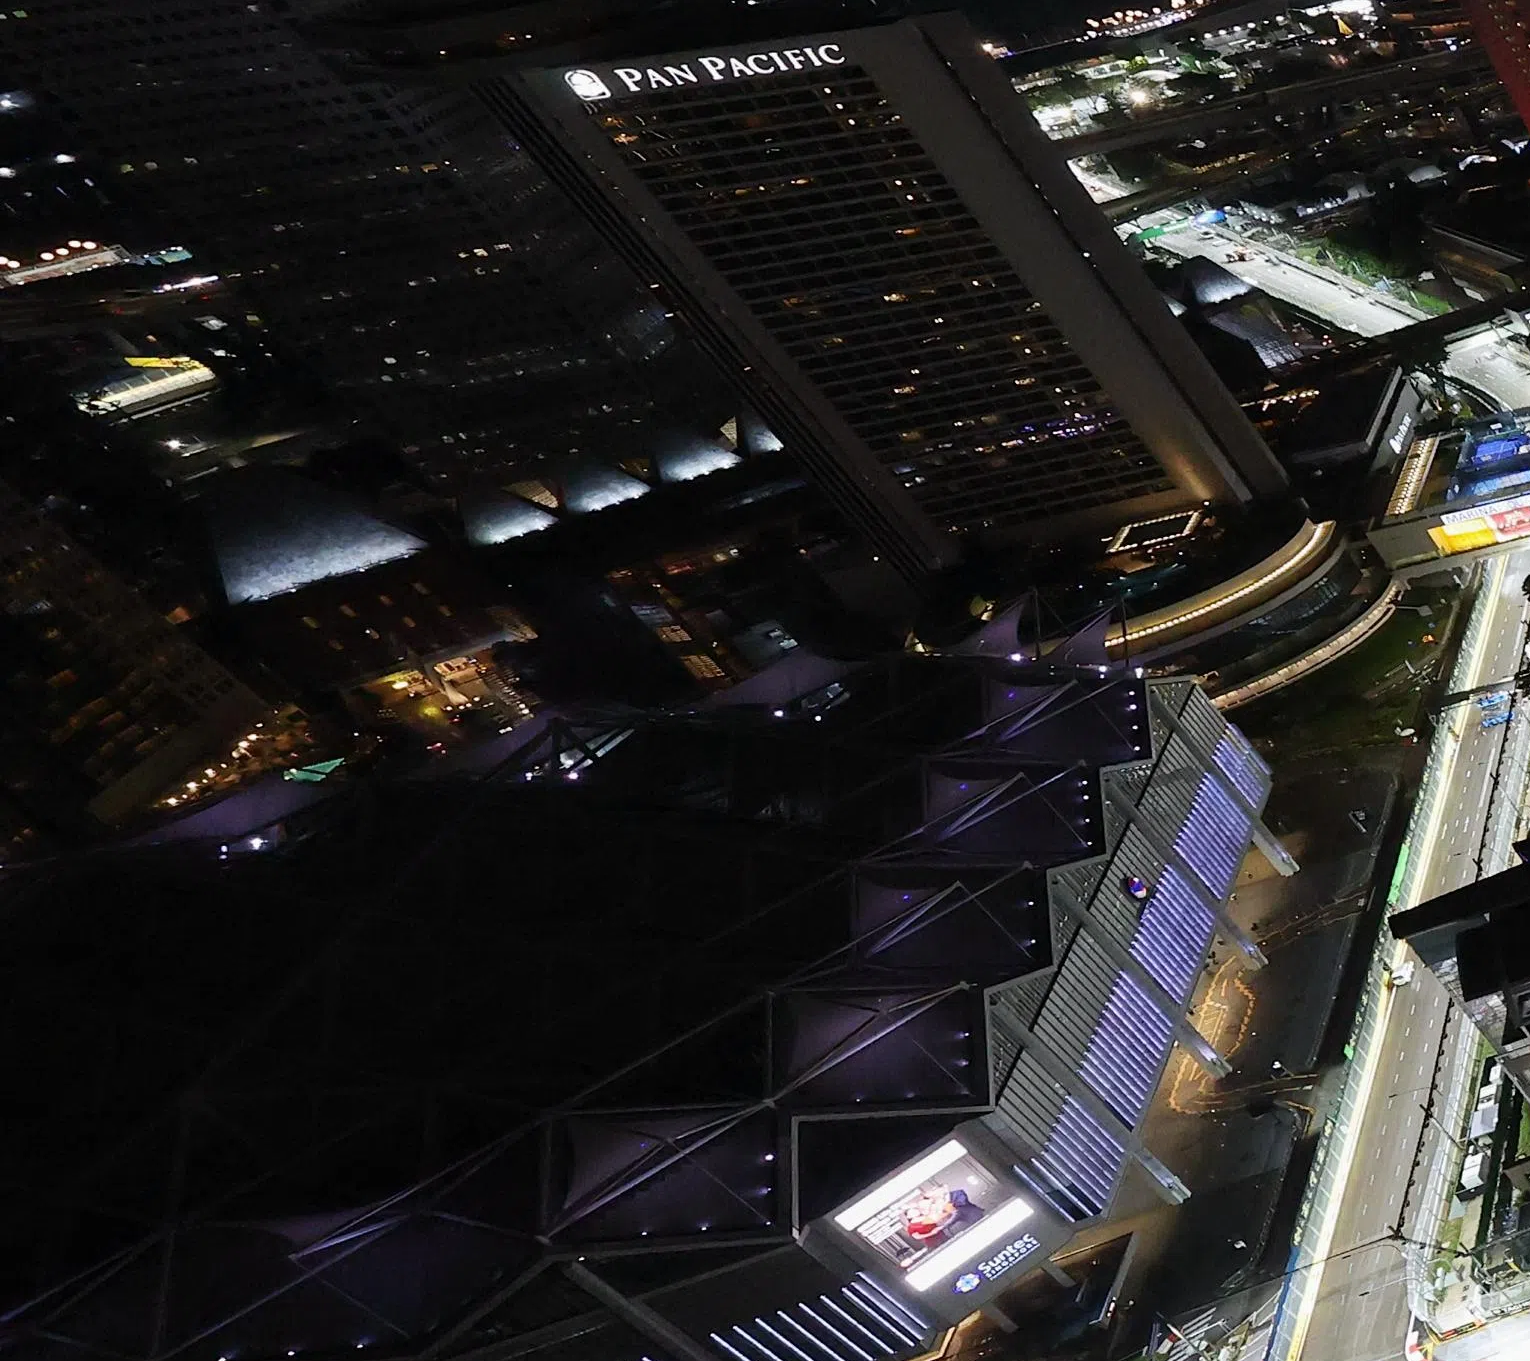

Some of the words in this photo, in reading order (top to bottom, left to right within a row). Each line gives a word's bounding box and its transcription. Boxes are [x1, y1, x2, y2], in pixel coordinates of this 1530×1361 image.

[613, 64, 698, 92] PAN
[698, 44, 846, 80] PACIFIC
[1445, 505, 1499, 525] MARINA
[978, 1232, 1036, 1275] Suntec
[985, 1239, 1041, 1280] SINGAPORE
